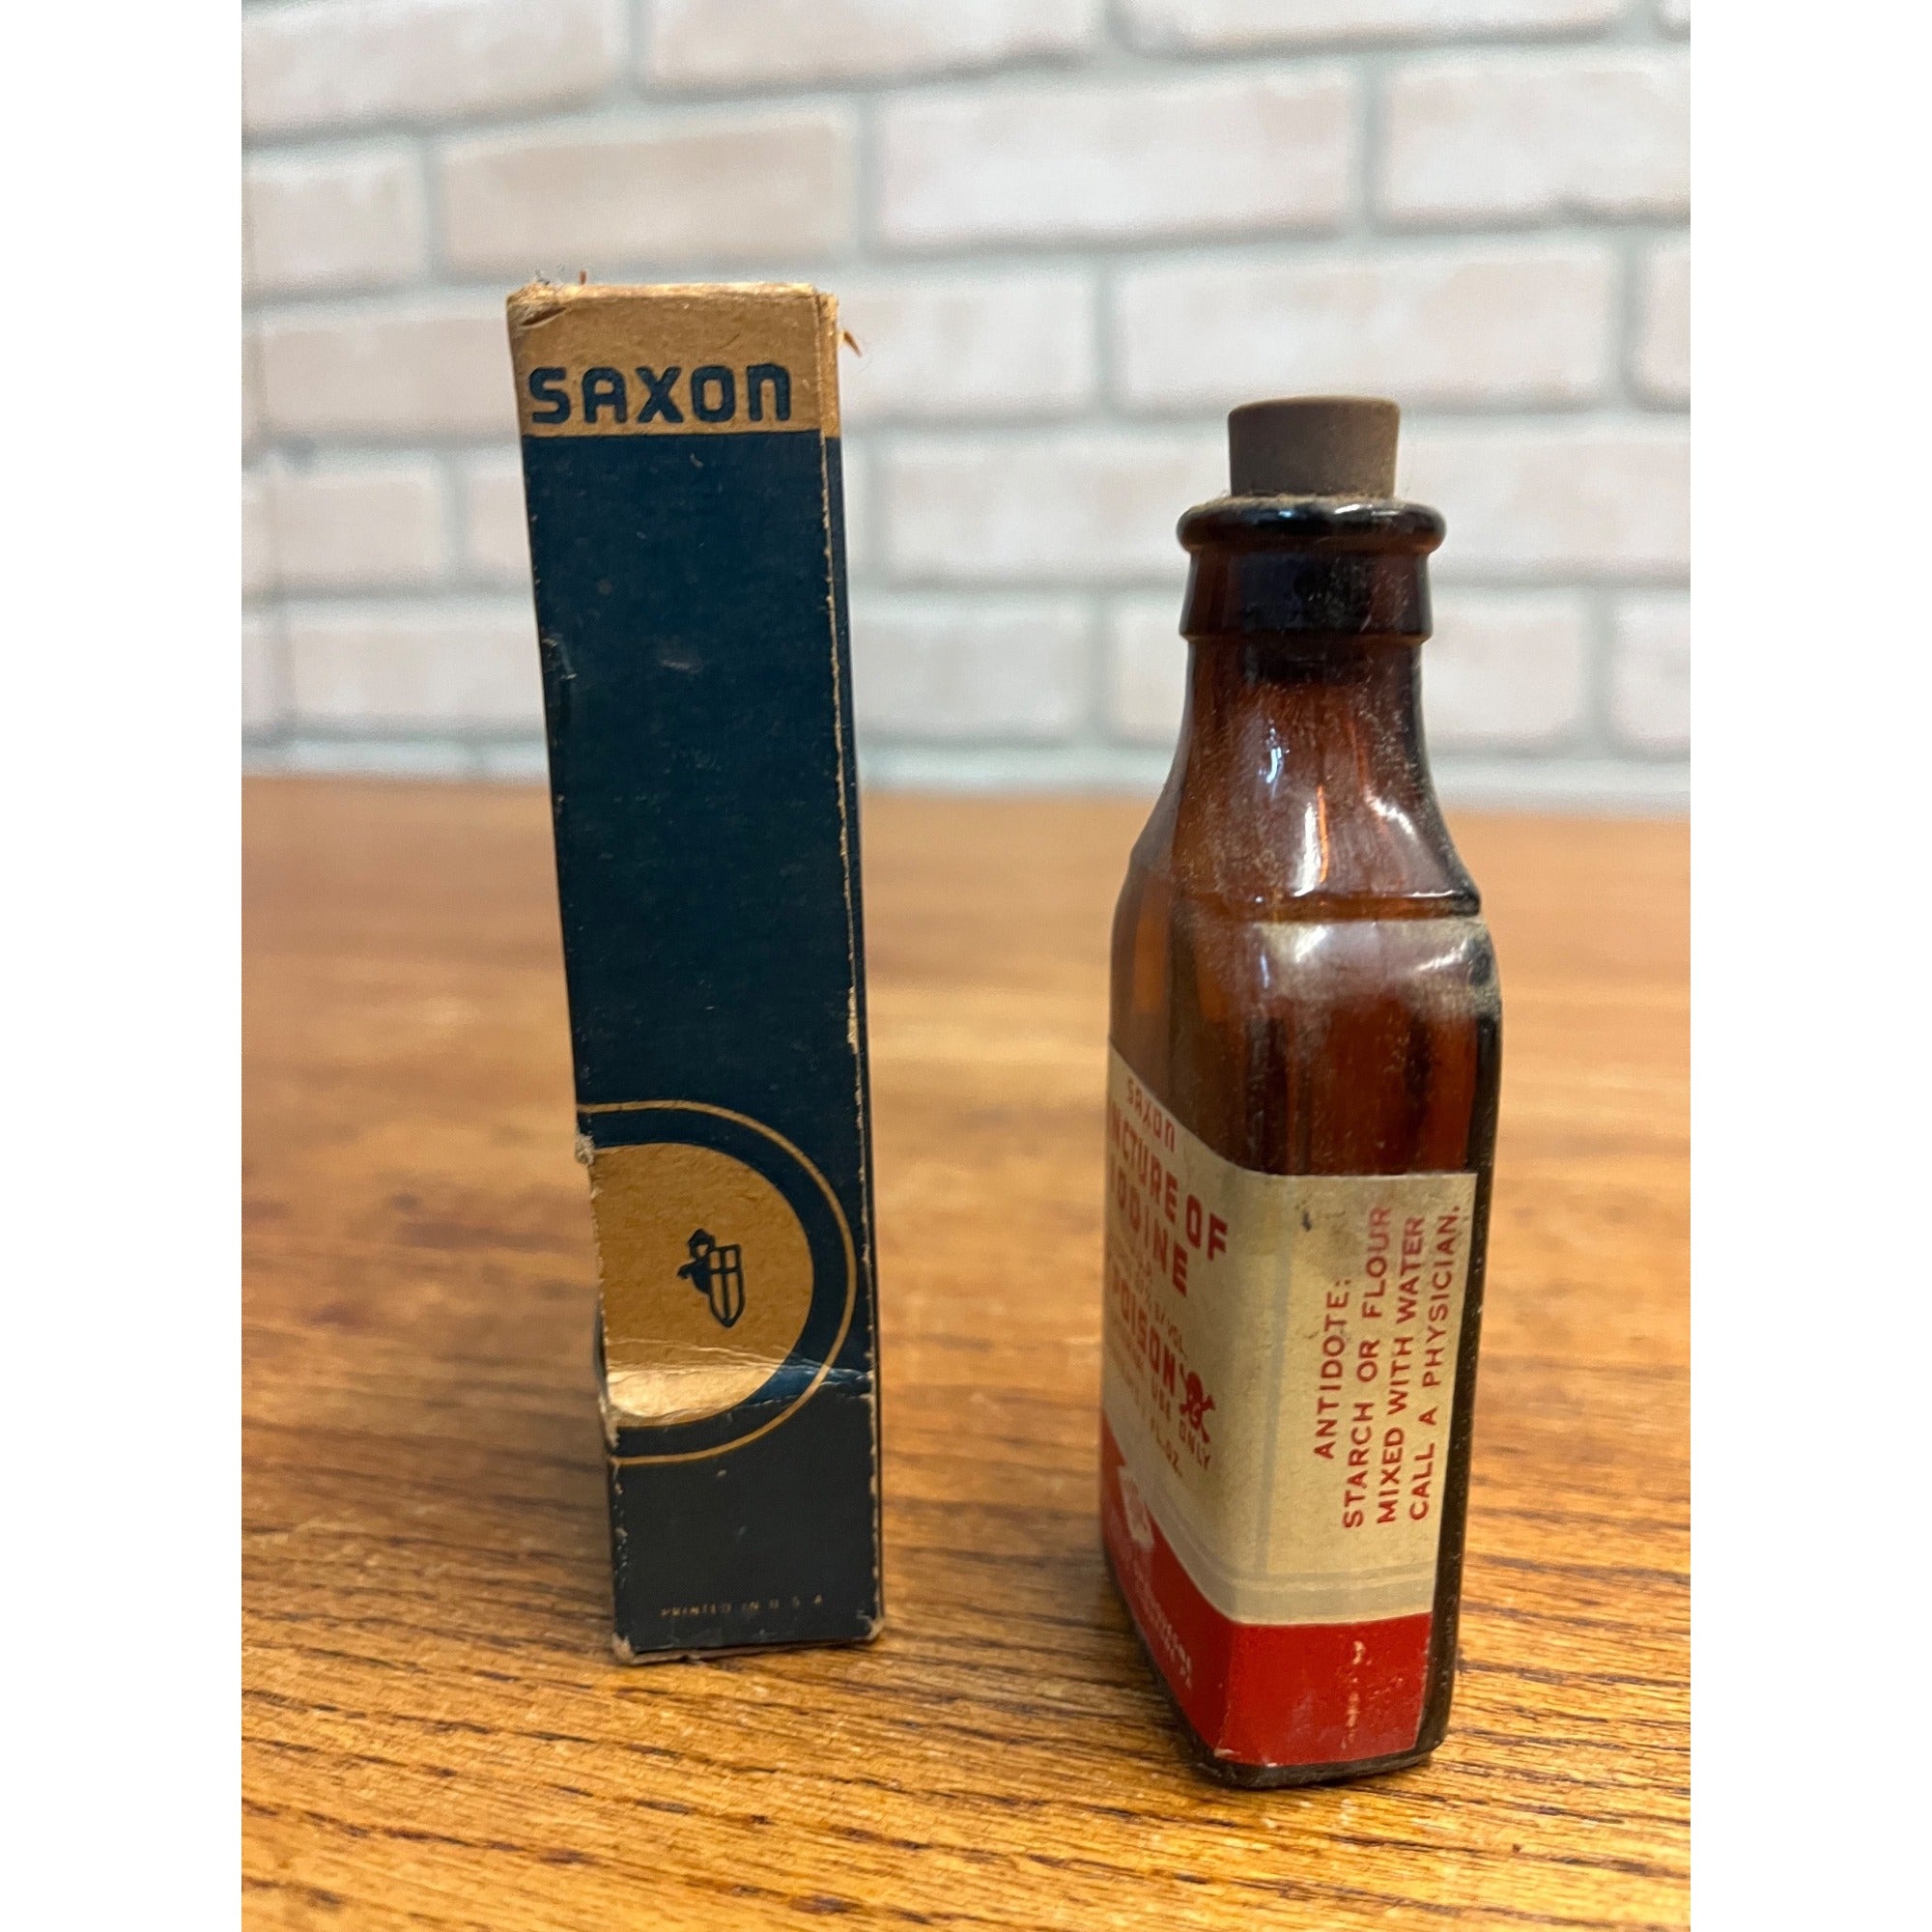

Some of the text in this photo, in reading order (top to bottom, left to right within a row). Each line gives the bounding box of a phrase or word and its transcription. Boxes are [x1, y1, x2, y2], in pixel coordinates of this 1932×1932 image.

[528, 362, 791, 425] SAXON
[1128, 1077, 1175, 1152] SAXON
[1185, 1194, 1228, 1262] OF
[1313, 1279, 1350, 1460] ANTIDOTE:
[1343, 1207, 1391, 1528] STARCH OR FLOUR
[1377, 1216, 1425, 1523] MIXED WITH WATER
[1409, 1206, 1461, 1520] CALL A PHYSICIAN.
